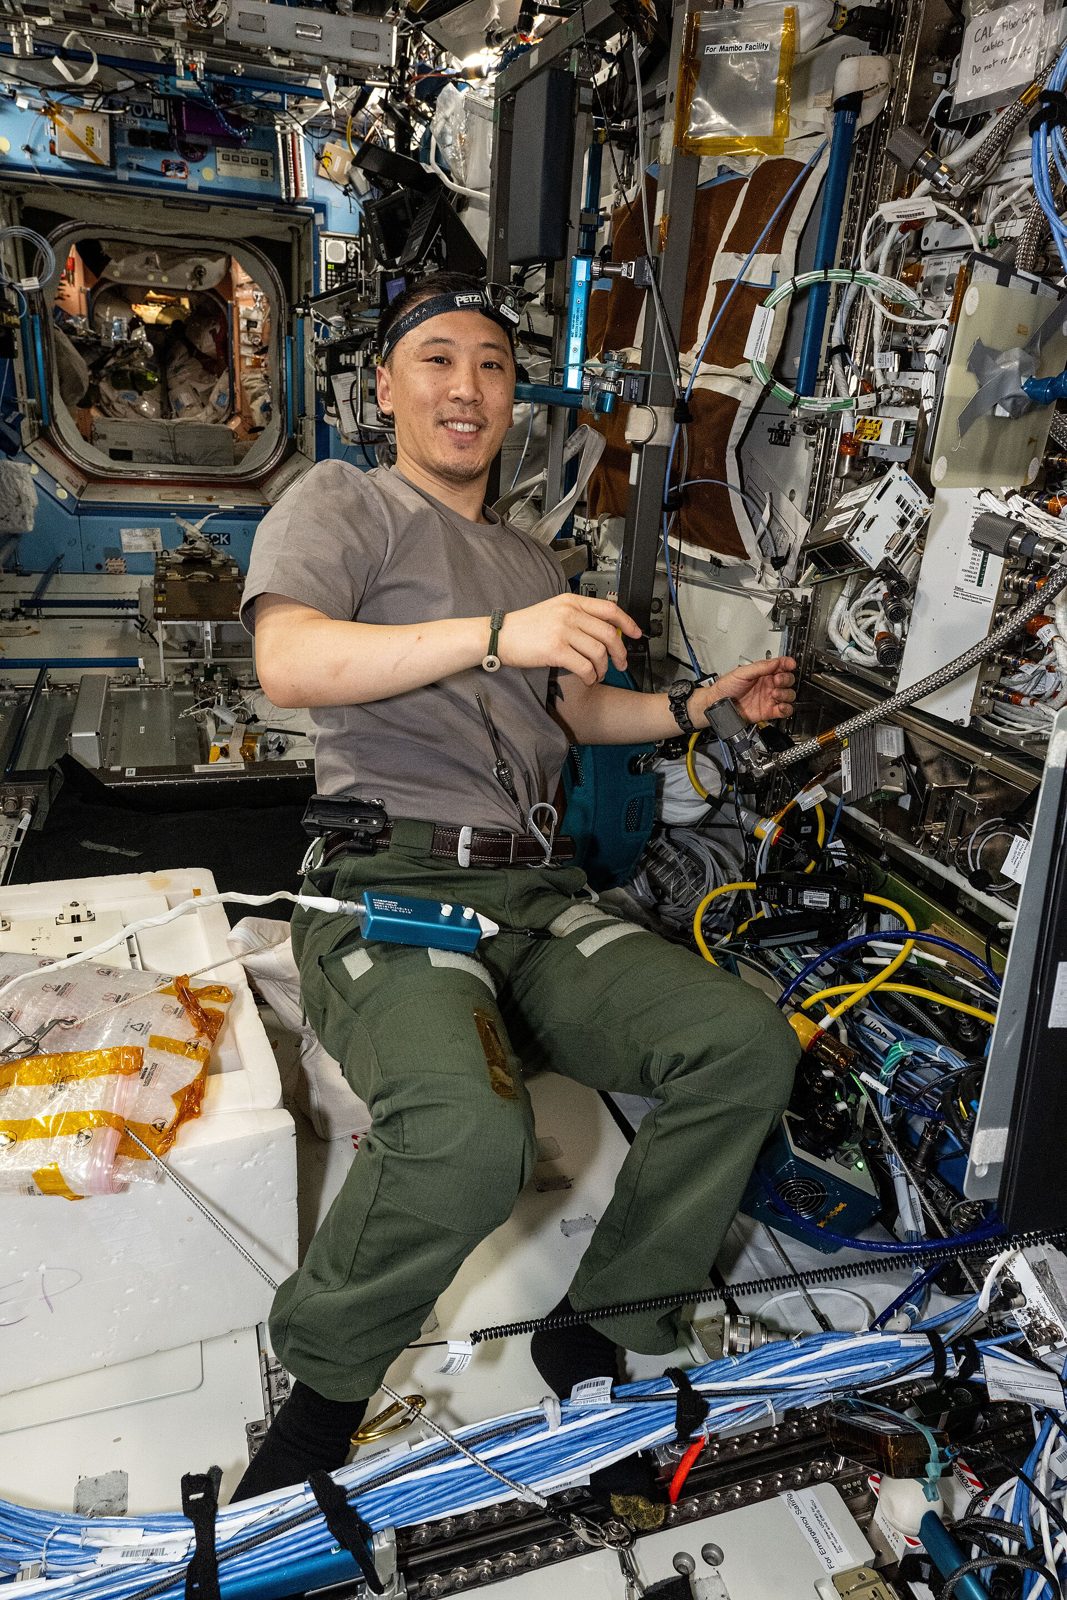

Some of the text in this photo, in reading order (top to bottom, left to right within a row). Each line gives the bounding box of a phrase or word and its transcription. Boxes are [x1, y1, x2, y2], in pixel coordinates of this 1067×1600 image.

[974, 26, 992, 43] CAL
[719, 44, 743, 52] Mambo
[745, 42, 769, 51] Facility
[972, 64, 981, 75] Do
[984, 59, 998, 70] not
[400, 307, 427, 328] TIKKA
[951, 1463, 971, 1489] POWER
[799, 1515, 827, 1555] Emergency
[822, 1555, 835, 1569] For
